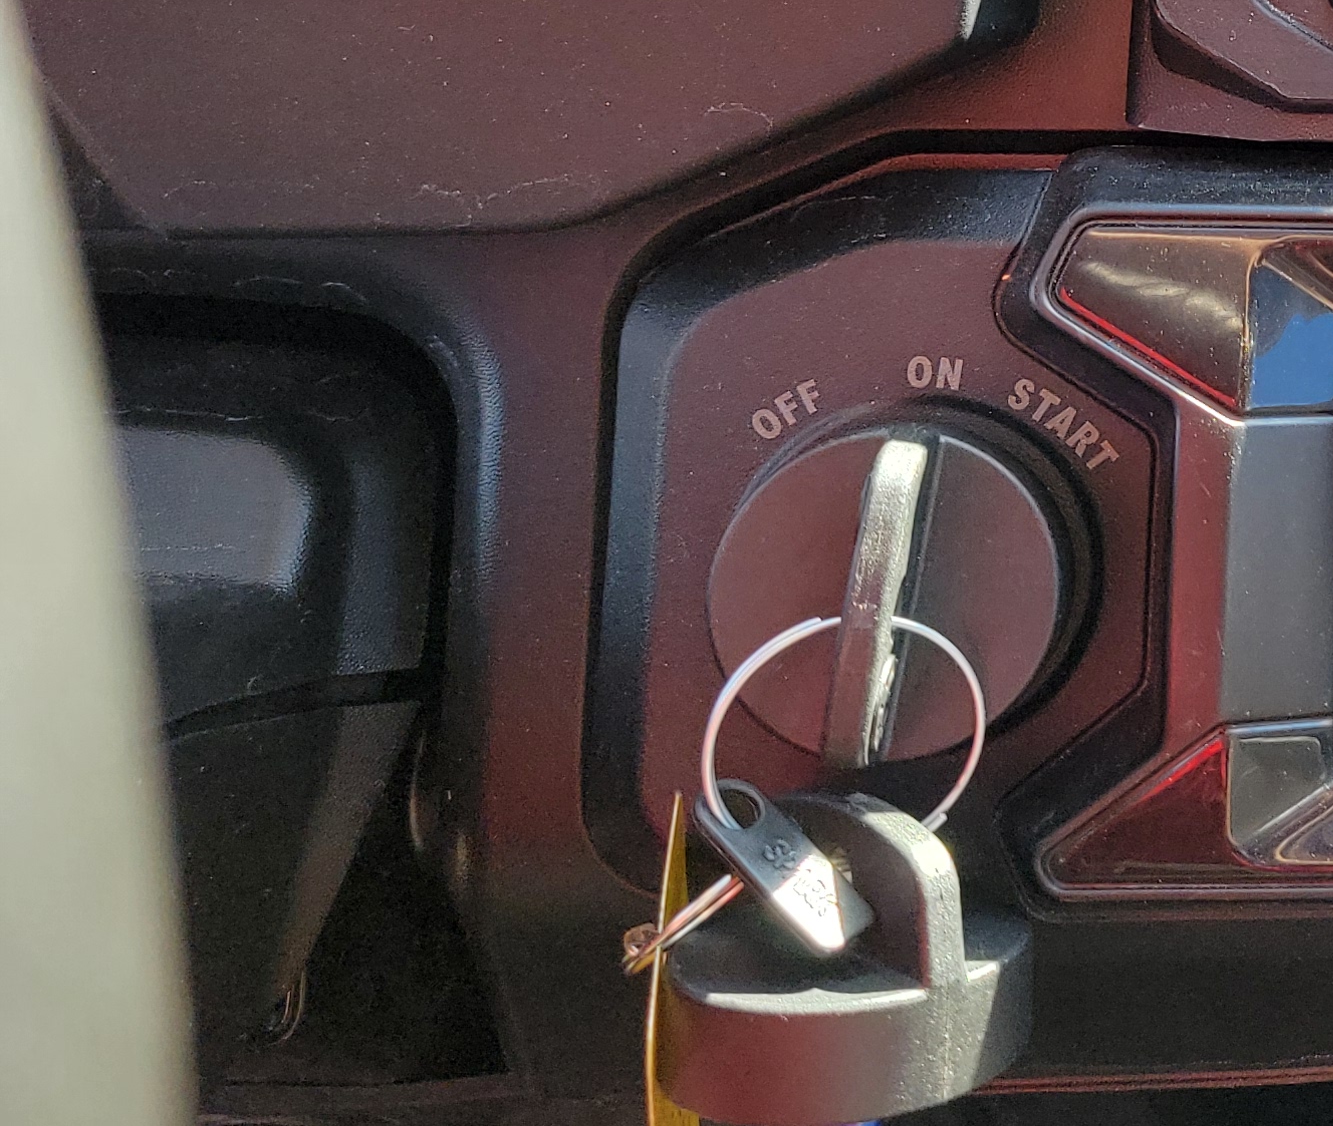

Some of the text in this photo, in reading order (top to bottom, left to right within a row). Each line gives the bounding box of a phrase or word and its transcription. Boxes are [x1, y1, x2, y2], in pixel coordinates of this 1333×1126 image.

[906, 355, 965, 391] ON
[751, 379, 821, 440] OFF
[1007, 378, 1121, 470] START
